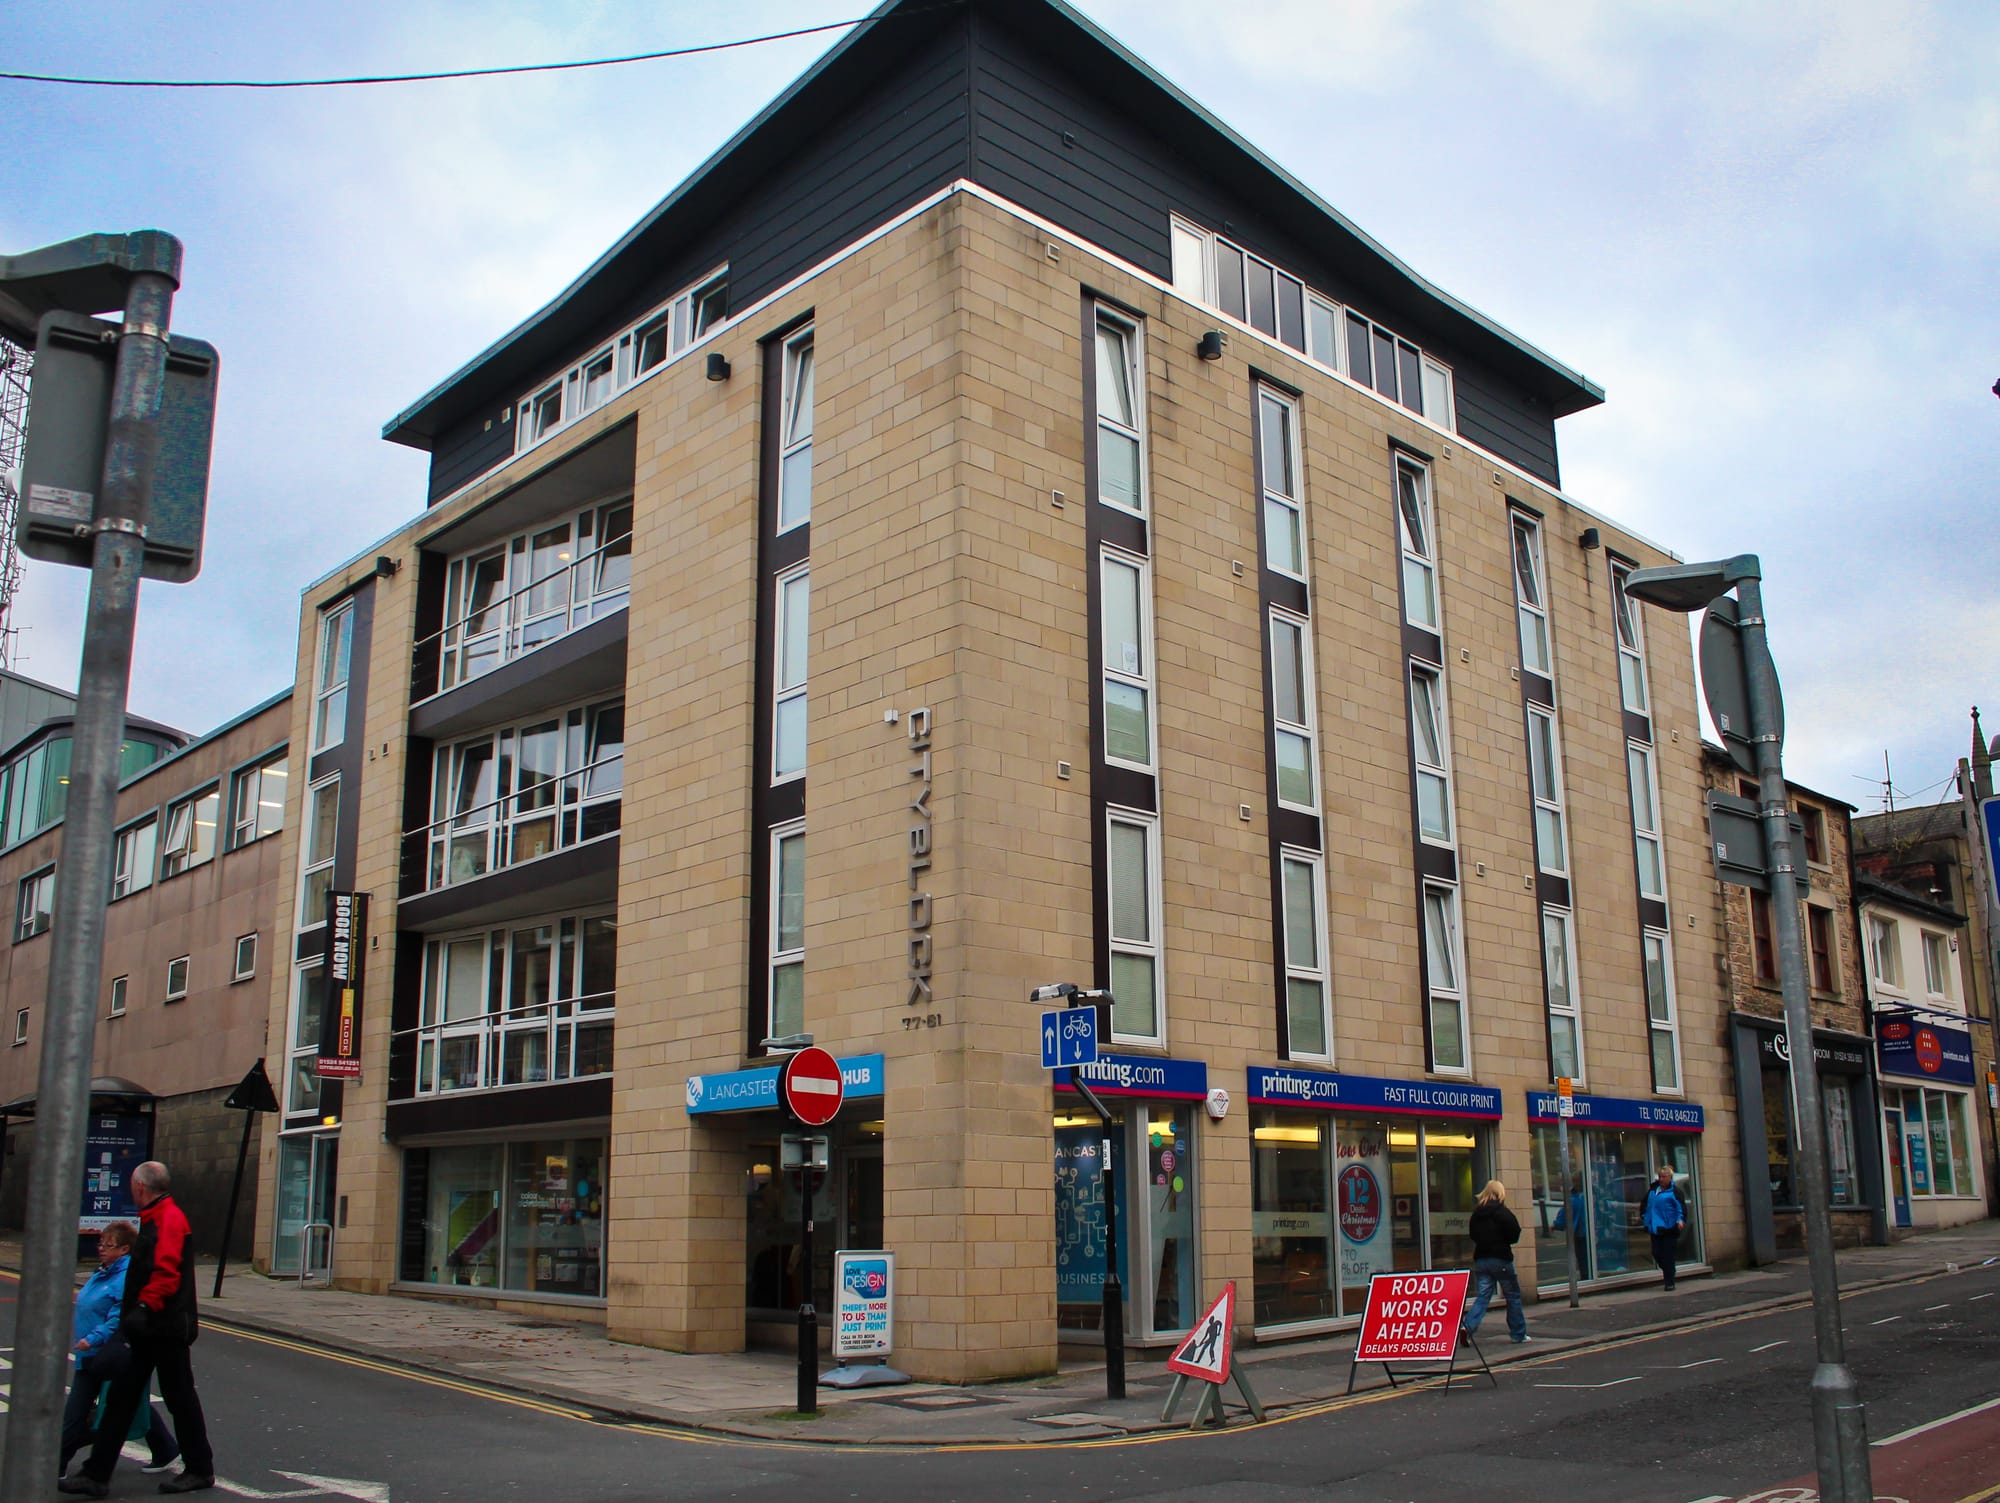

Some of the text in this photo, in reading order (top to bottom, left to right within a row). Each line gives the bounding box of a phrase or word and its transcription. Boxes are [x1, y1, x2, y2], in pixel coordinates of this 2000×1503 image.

[908, 706, 932, 1006] CITYBLOCK
[333, 896, 351, 980] BOOK NOW
[1079, 1057, 1165, 1088] rinting.com
[709, 1068, 870, 1101] LANCASTER HUB
[1262, 1071, 1494, 1109] printing.com FAST FULL COLOUR PRINT
[1639, 1106, 1651, 1119] TEL
[1654, 1108, 1674, 1122] 01524
[1674, 1109, 1699, 1123] 846222
[1347, 1177, 1370, 1204] 12
[1341, 1213, 1376, 1225] Christmas
[1345, 1249, 1357, 1261] TO
[1353, 1262, 1369, 1274] OFF
[846, 1274, 885, 1288] DESIGN
[1391, 1277, 1445, 1296] ROAD
[842, 1302, 887, 1312] THERE'S MORE
[1381, 1299, 1448, 1318] WORKS
[842, 1312, 887, 1321] TO US THAN
[841, 1321, 887, 1332] JUST PRINT
[1376, 1321, 1443, 1340] AHEAD
[1365, 1342, 1447, 1354] DELAYS POSSIBLE
